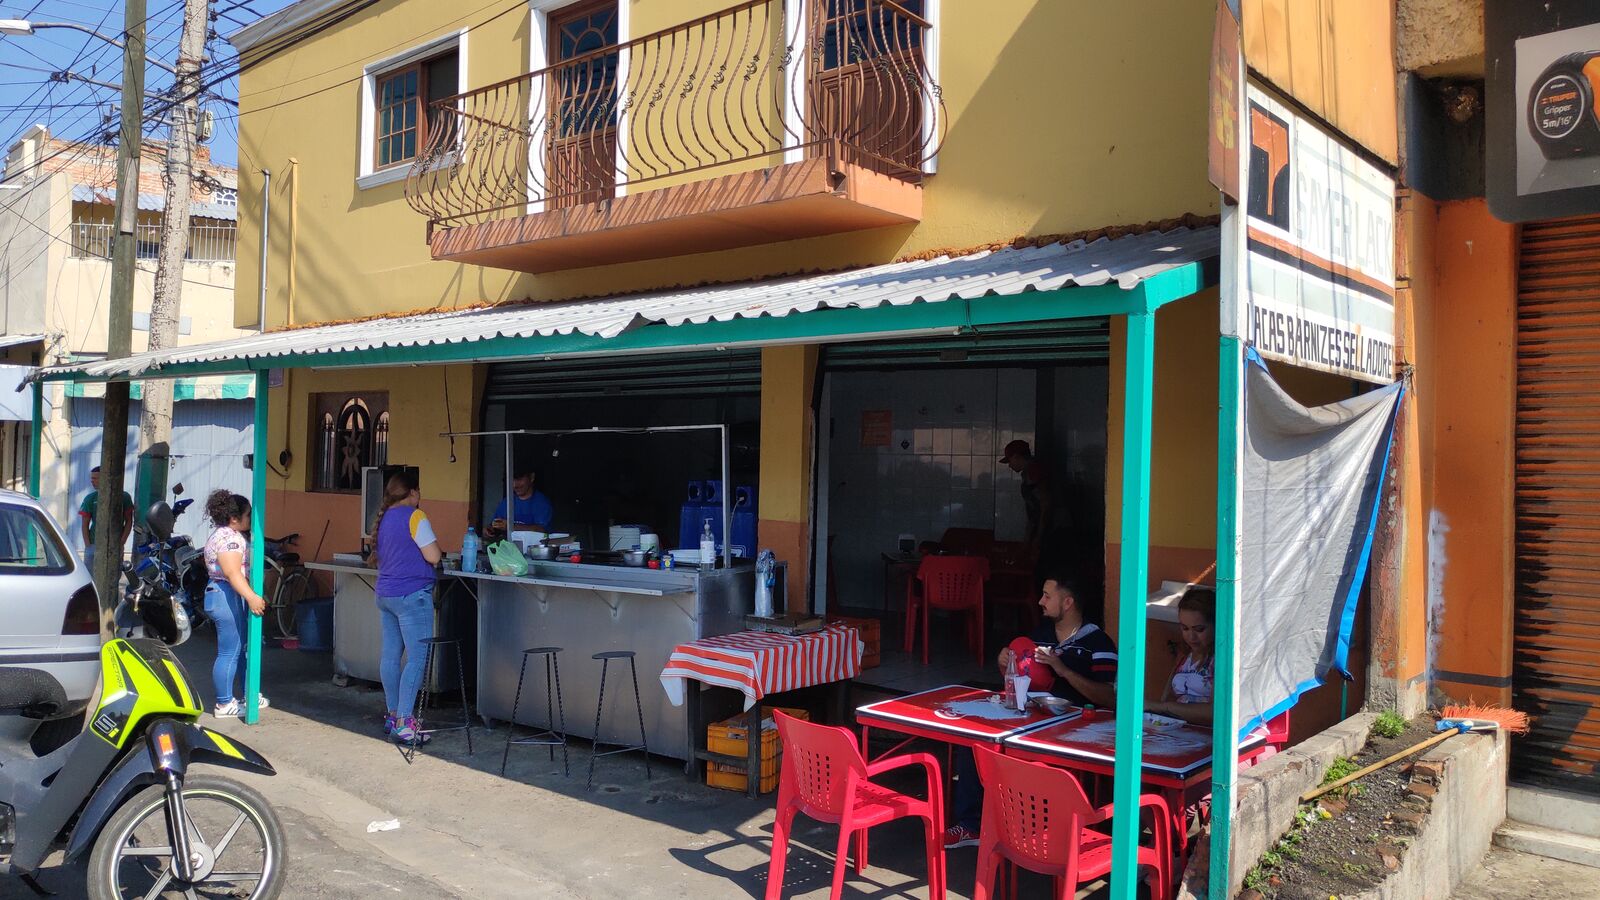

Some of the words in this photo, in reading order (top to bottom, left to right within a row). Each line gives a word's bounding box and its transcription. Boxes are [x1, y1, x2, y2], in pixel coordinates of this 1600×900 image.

[1544, 104, 1573, 115] Gripper
[1246, 303, 1285, 354] LACAS
[1286, 314, 1342, 368] BARNIZES
